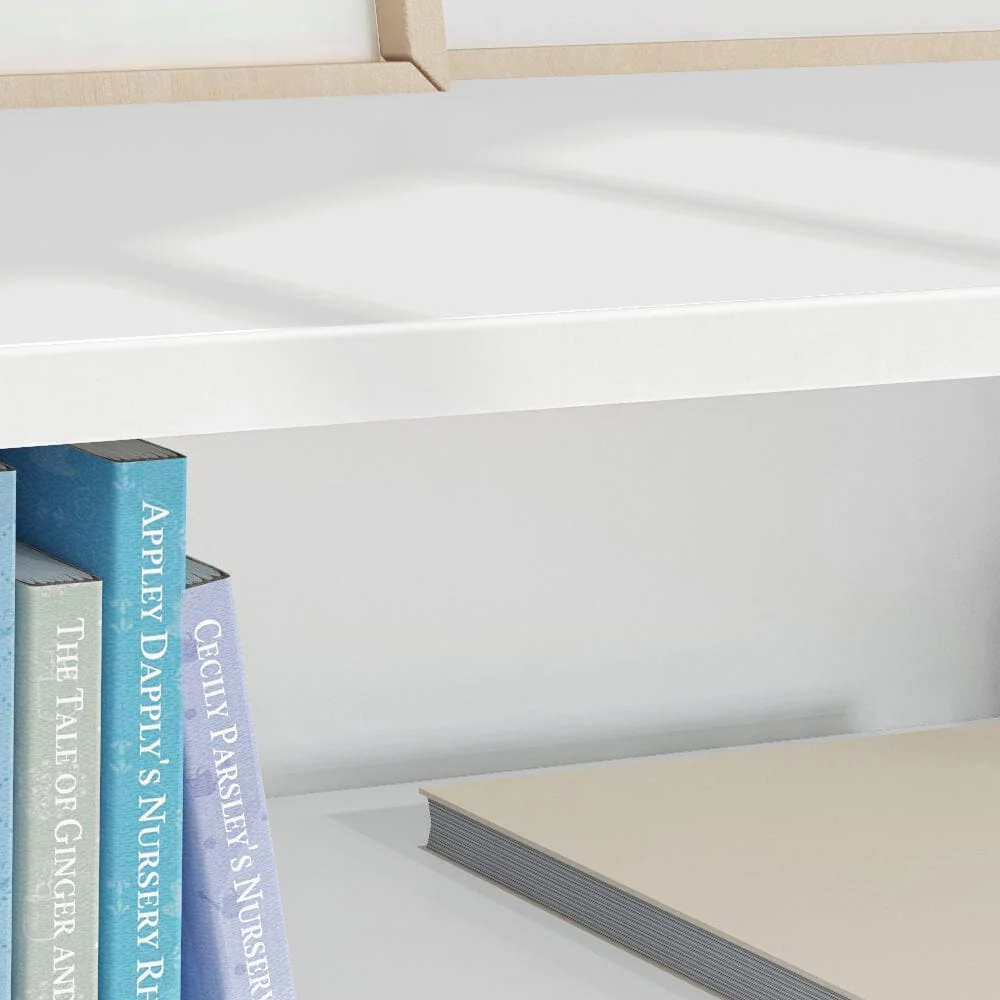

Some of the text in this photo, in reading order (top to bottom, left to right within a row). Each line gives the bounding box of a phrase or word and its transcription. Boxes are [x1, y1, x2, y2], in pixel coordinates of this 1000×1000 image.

[140, 500, 170, 622] APPLEY
[56, 617, 84, 682] THE
[138, 632, 169, 786] DAPPLY'S
[194, 619, 230, 719] CECILY
[55, 688, 84, 765] TALE
[54, 773, 77, 811] OF
[210, 723, 258, 873] PARSLEY'S
[53, 818, 83, 939] GINGER
[137, 793, 166, 949] NURSERY
